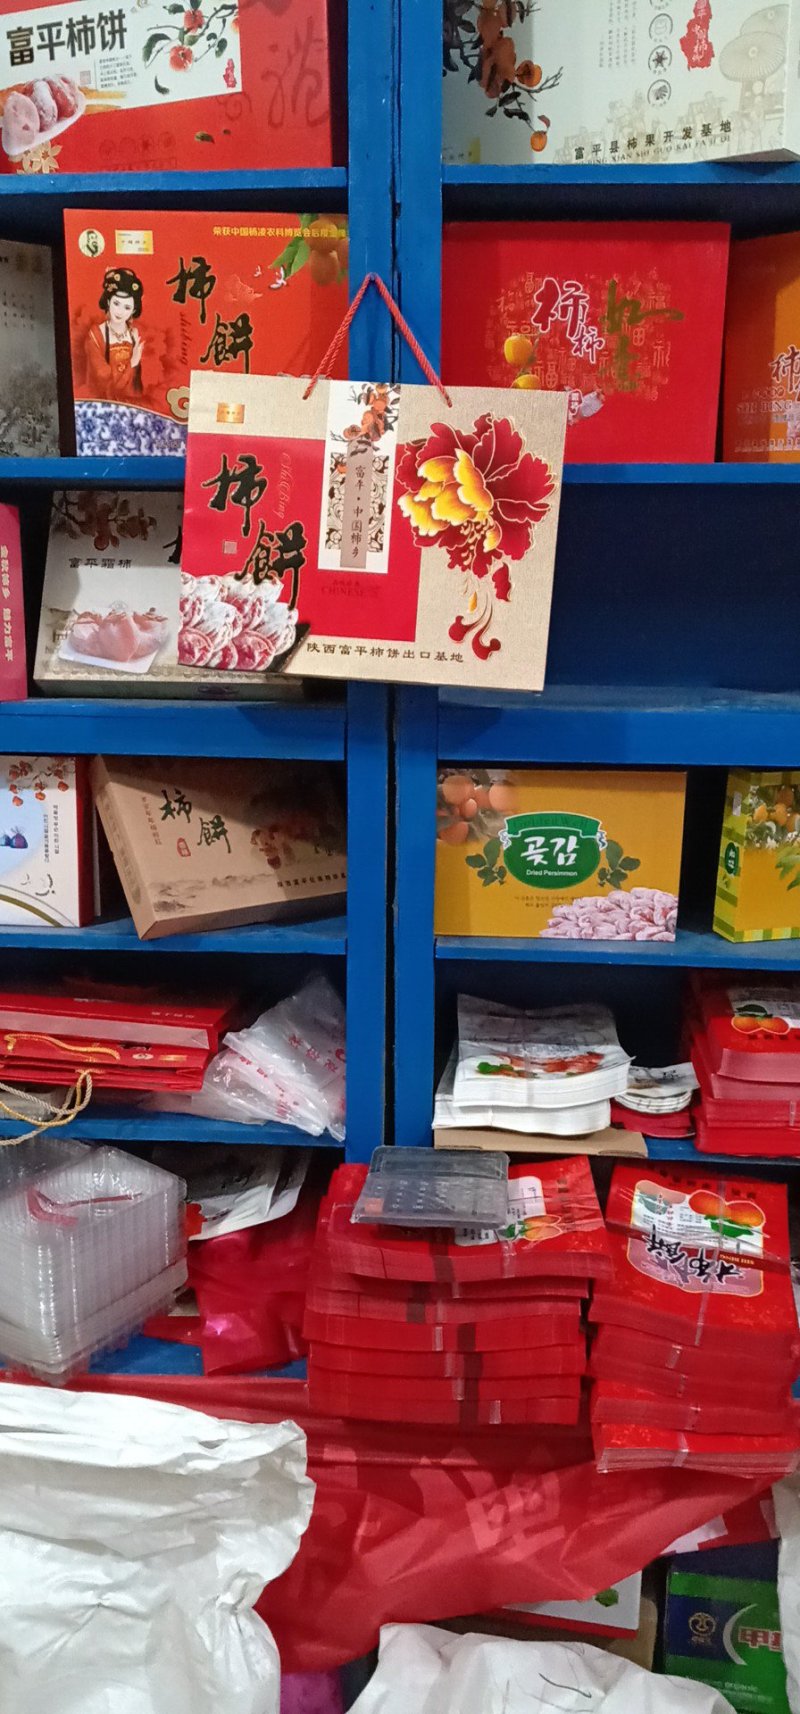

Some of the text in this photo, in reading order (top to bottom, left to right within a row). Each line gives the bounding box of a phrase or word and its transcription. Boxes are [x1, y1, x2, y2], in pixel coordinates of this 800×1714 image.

[6, 9, 127, 67] 富平柿饼
[574, 119, 732, 160] 富平县柿果开发基地
[69, 557, 133, 569] 富平霜柿
[306, 642, 464, 663] 陕西富平柿饼出口基地
[520, 835, 580, 866] 곶감
[544, 869, 578, 877] Persimmon
